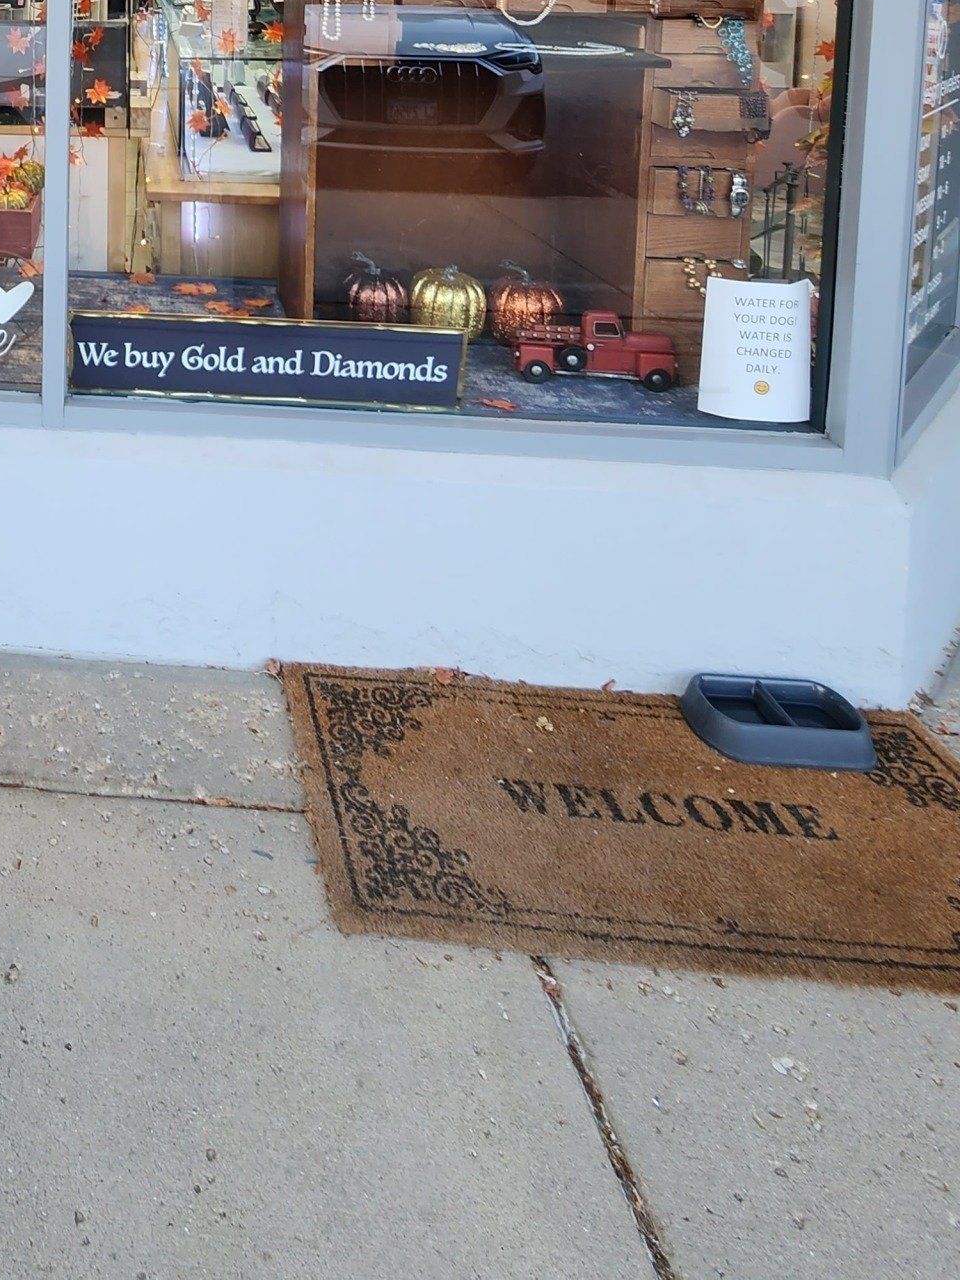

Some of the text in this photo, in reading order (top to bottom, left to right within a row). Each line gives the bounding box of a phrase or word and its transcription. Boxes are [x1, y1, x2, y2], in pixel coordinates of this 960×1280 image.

[734, 296, 800, 309] WATER FOR
[733, 312, 766, 325] YOUR
[739, 330, 793, 343] WATER IS
[736, 346, 793, 359] CHANGED
[77, 341, 449, 384] We buy Gold and Diamonds
[496, 774, 840, 842] WELCOME
